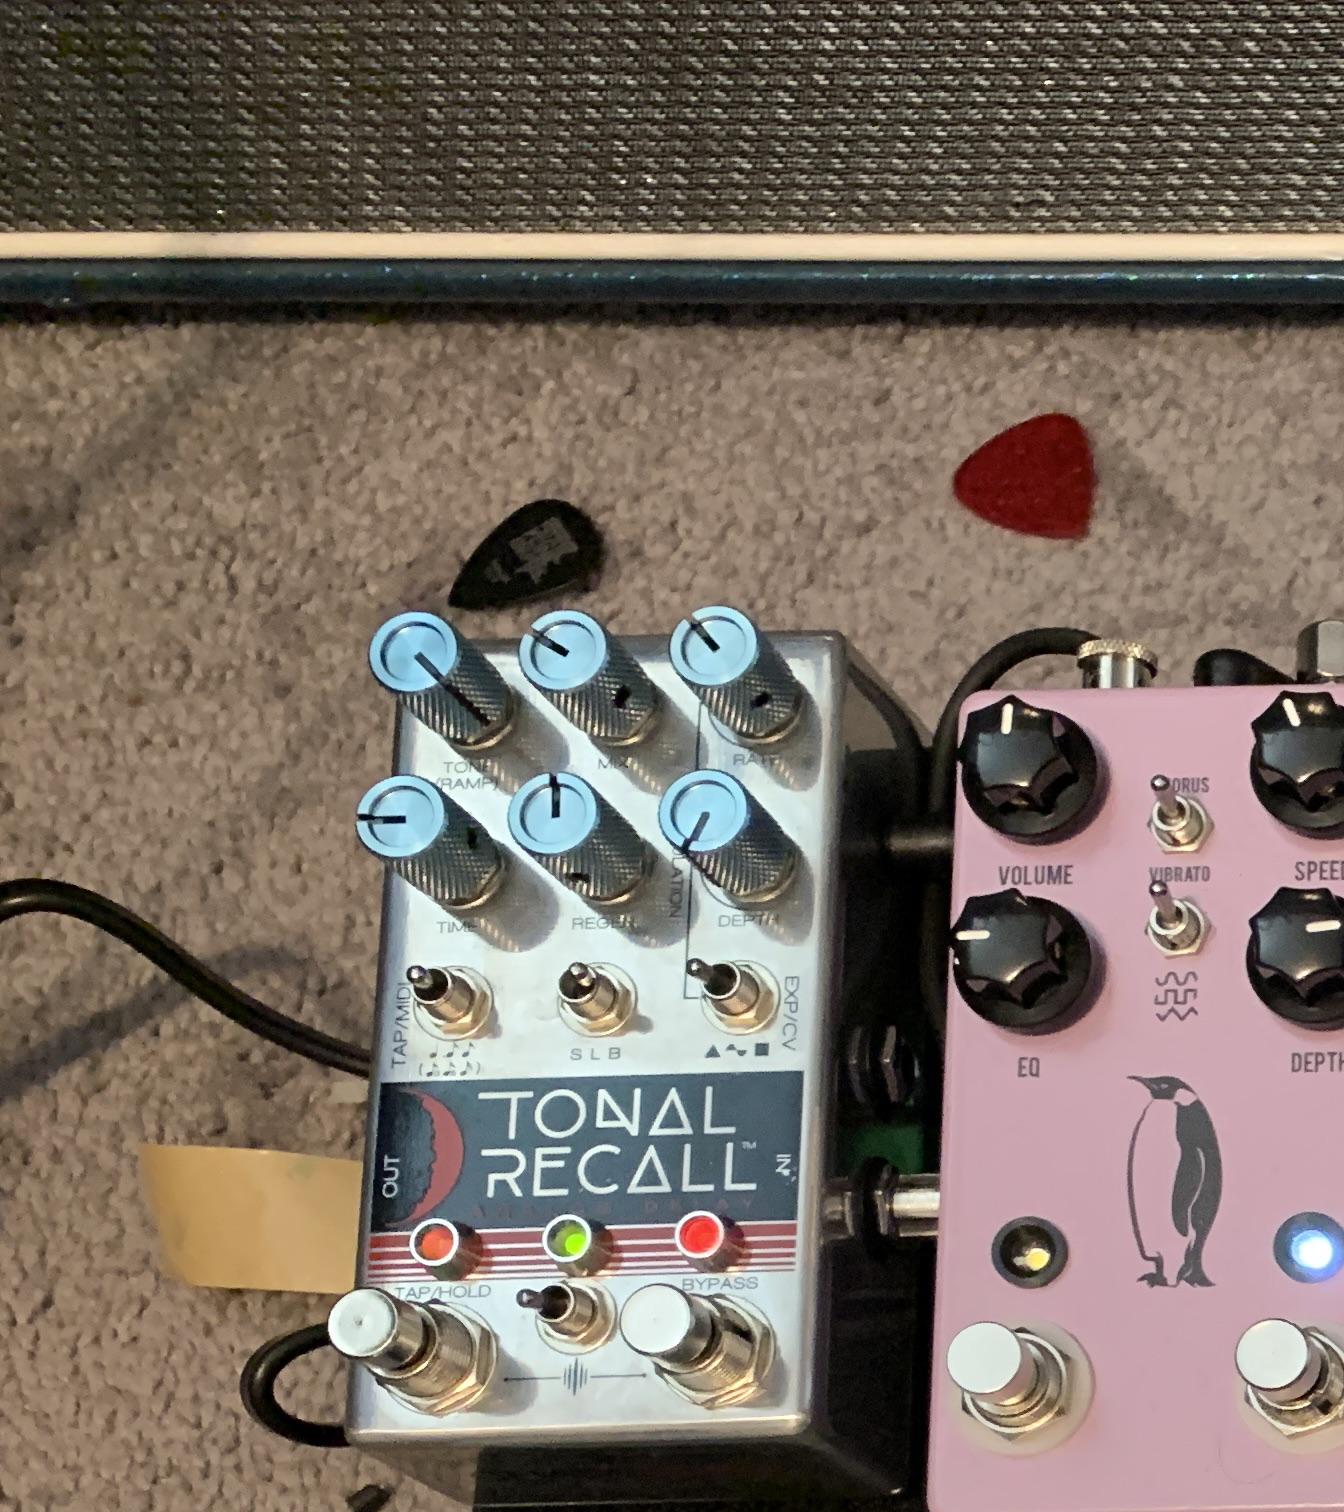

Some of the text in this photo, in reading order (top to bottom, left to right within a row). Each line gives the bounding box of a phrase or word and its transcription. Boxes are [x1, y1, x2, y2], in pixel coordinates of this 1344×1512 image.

[597, 757, 629, 769] MIX
[1167, 777, 1210, 793] ORUS
[669, 850, 684, 919] LATION
[998, 864, 1074, 886] VOLUME
[1149, 866, 1211, 882] VIBRATO
[717, 913, 779, 928] DEPTH
[782, 975, 800, 1051] EXP/CV
[390, 982, 412, 1069] TAP/MIDI
[1016, 1057, 1040, 1078] EQ
[478, 1086, 737, 1140] TONAL
[480, 1142, 757, 1198] RECALL
[775, 1153, 792, 1174] IN
[382, 1154, 400, 1198] OUT
[394, 1284, 492, 1301] TAP/HOLD
[682, 1276, 759, 1292] BYPASS
